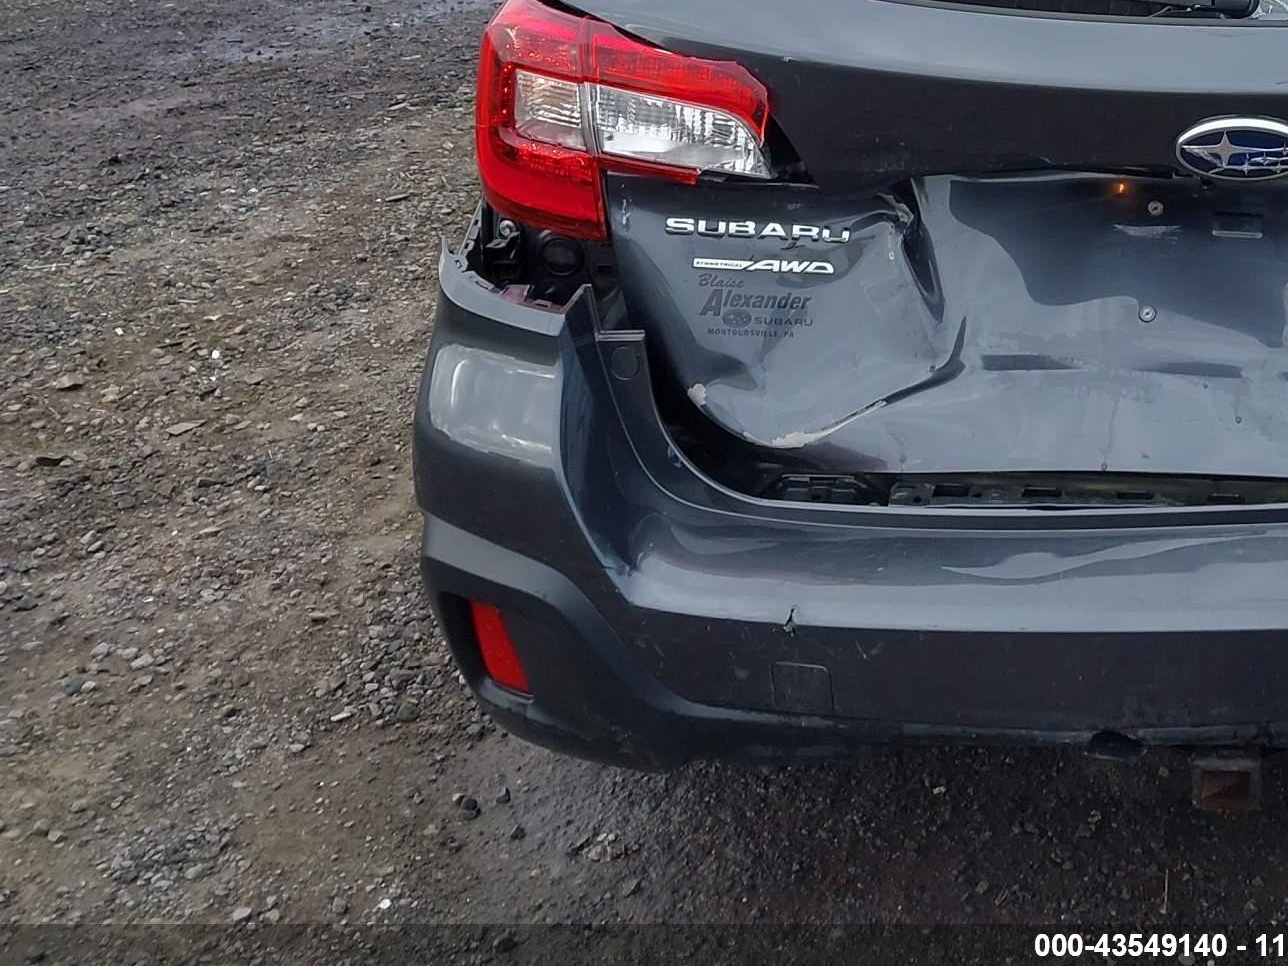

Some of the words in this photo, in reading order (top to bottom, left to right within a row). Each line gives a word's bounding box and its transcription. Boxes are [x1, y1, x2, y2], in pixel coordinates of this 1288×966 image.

[665, 217, 851, 243] SUBARU
[746, 259, 835, 274] AWD
[698, 273, 745, 289] Blaise
[699, 288, 812, 317] Alexander
[754, 316, 814, 327] SUBARU
